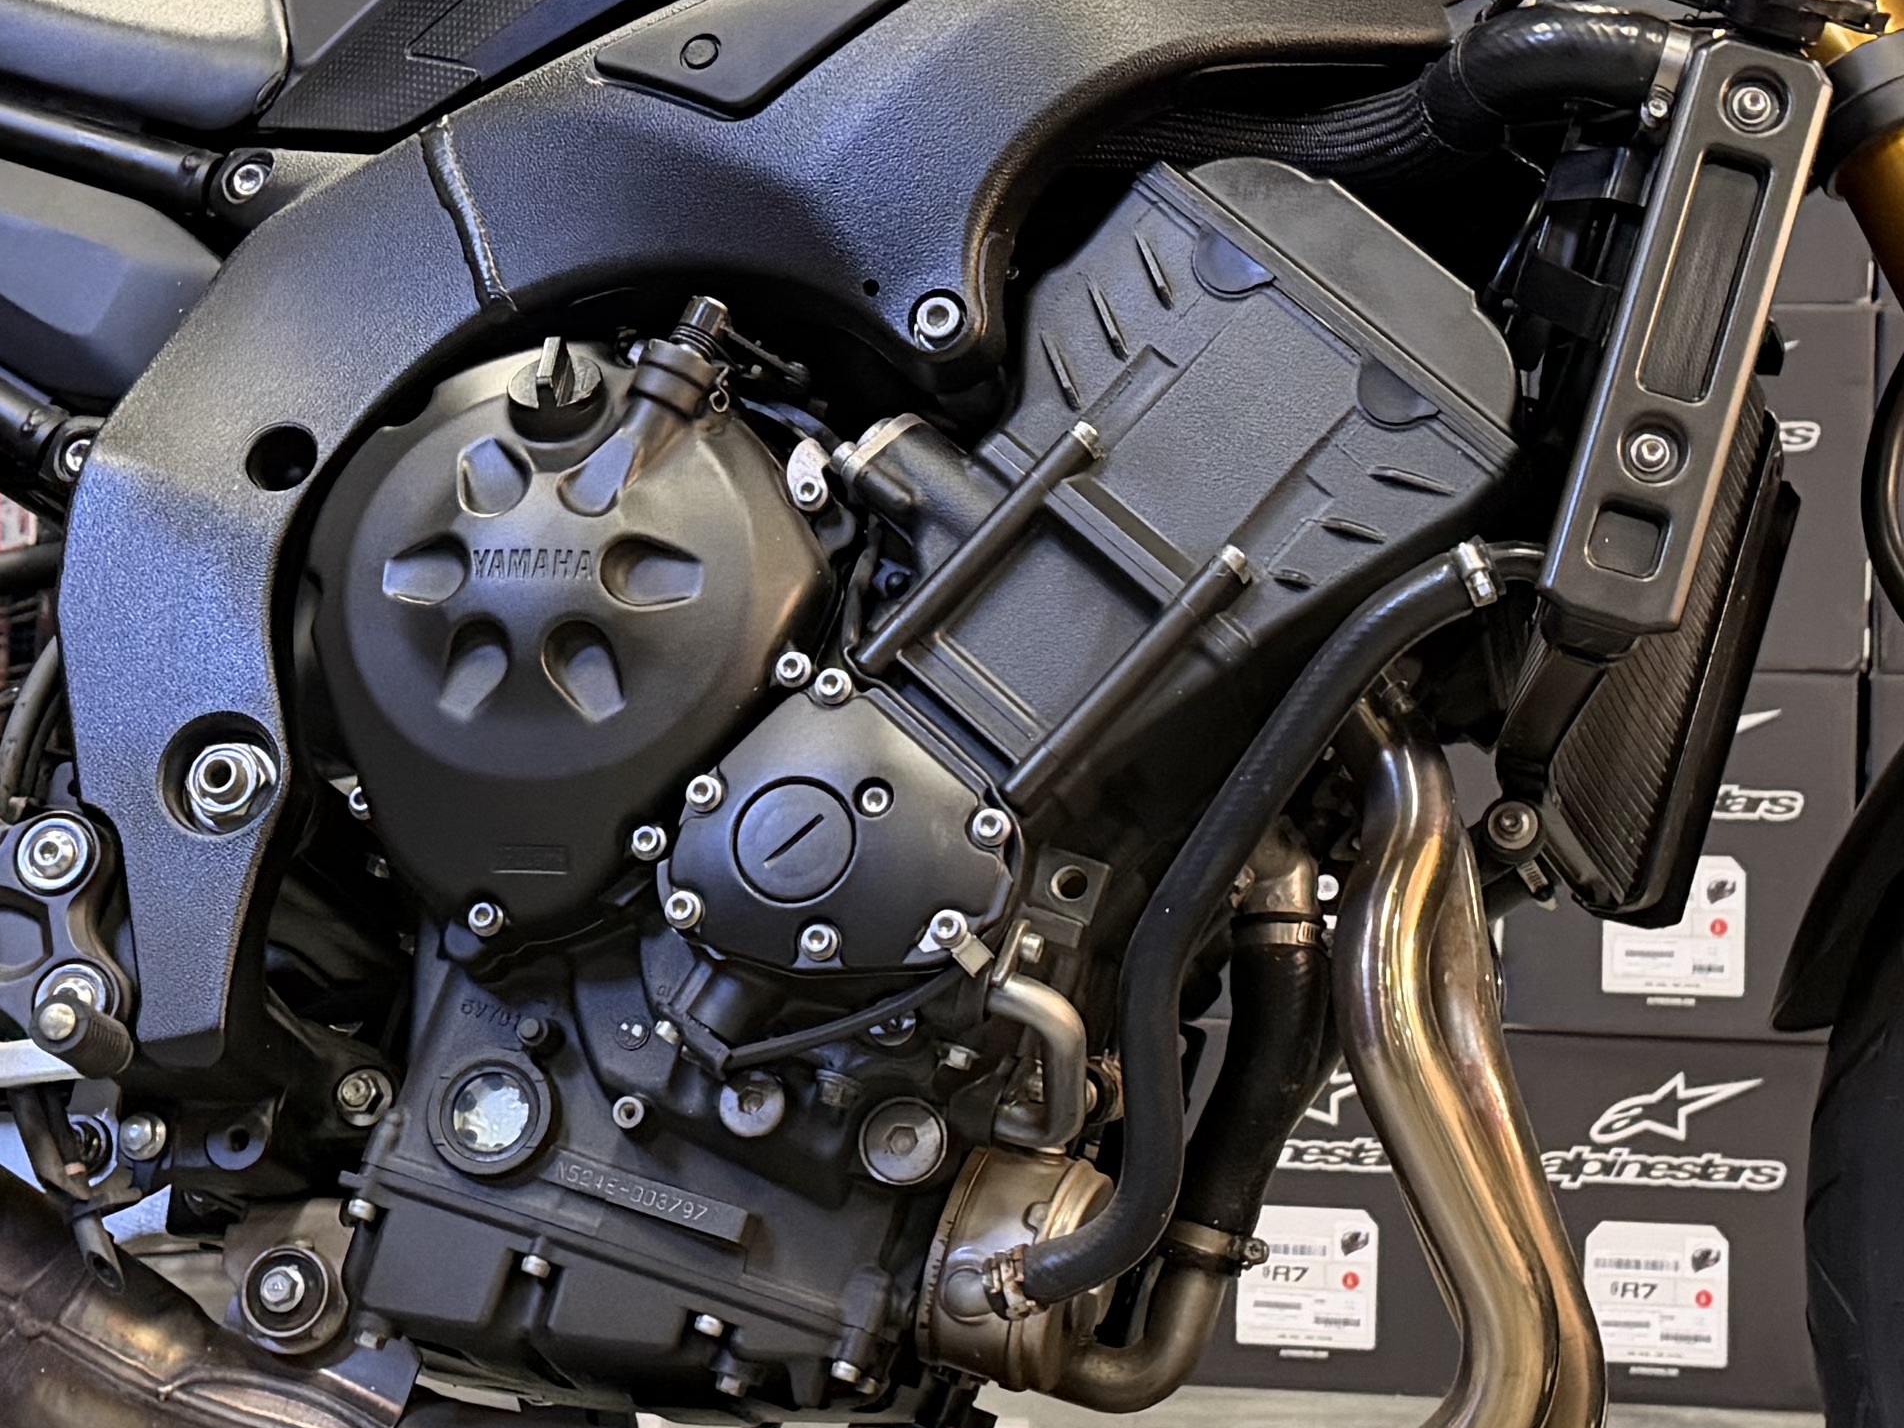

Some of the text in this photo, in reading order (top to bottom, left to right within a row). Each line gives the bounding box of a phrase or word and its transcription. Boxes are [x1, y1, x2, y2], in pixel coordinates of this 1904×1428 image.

[472, 548, 594, 580] YAMAHA
[1540, 1145, 1788, 1190] alpinestars
[1272, 1264, 1309, 1283] R7
[1620, 1281, 1658, 1300] R7
